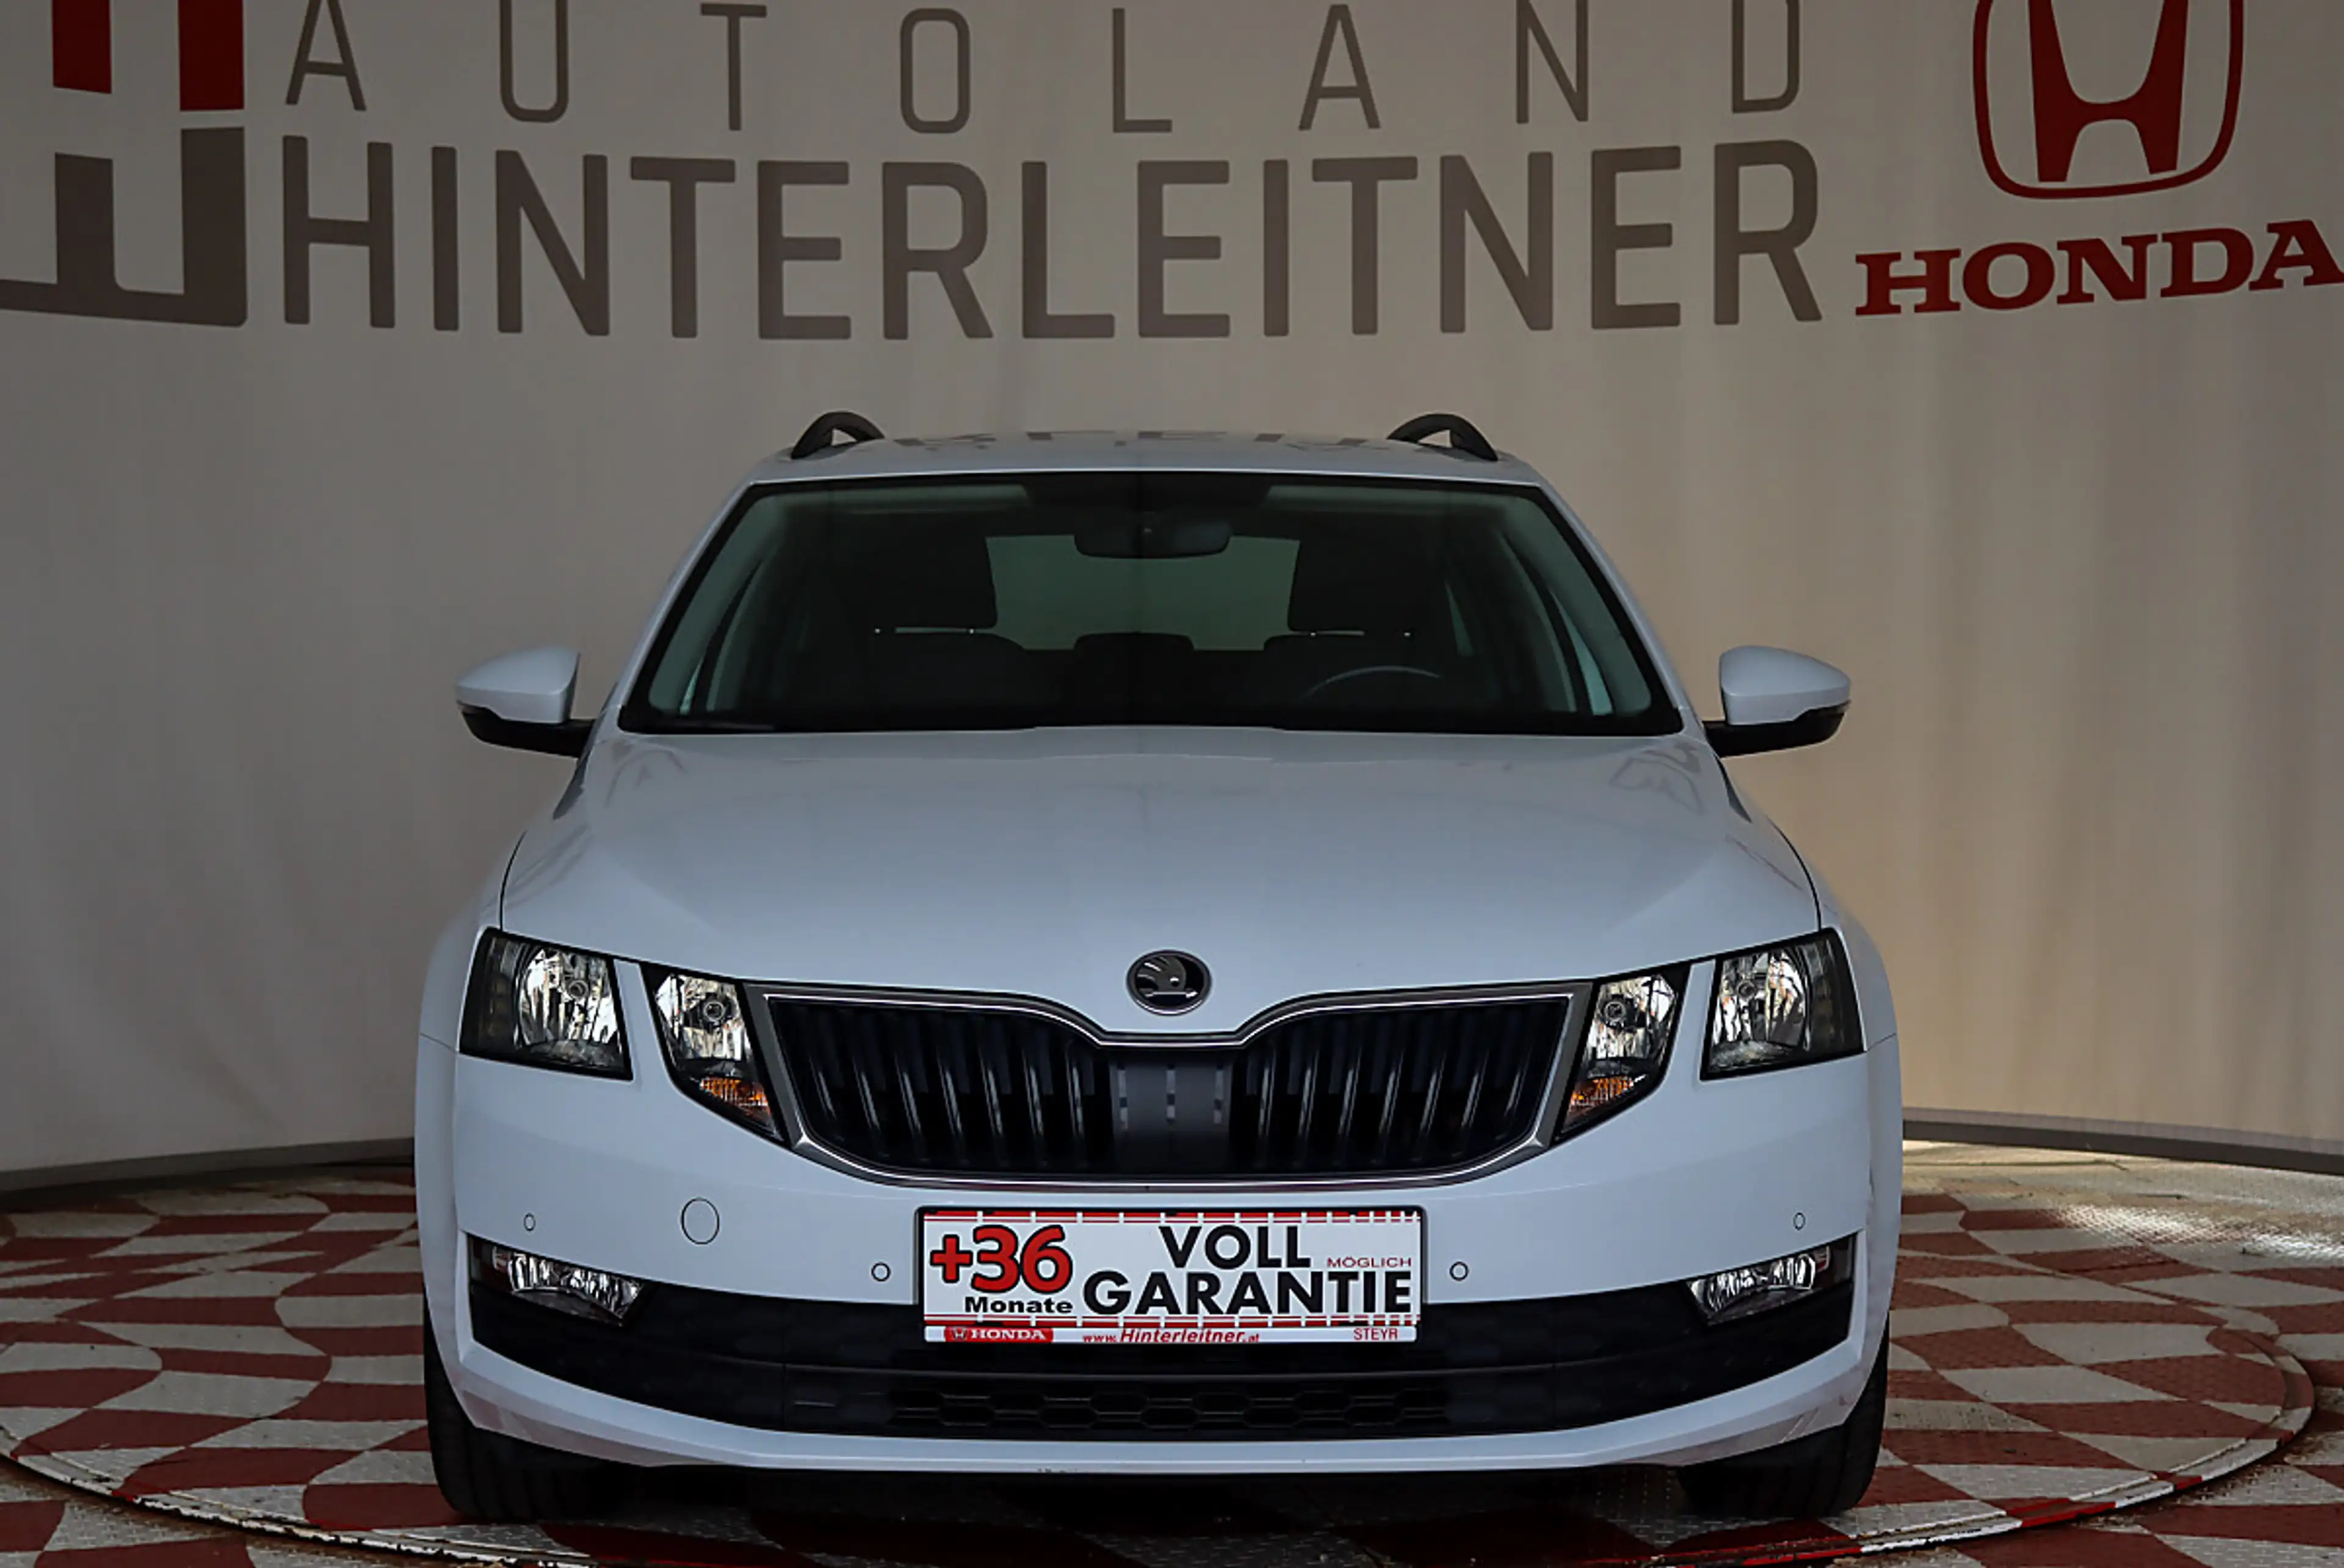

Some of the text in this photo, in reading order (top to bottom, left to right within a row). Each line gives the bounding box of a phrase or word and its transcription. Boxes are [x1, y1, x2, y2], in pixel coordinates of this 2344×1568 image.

[284, 0, 1801, 133] AUTOLAND
[282, 135, 1823, 340] HINTERLEITNER
[1854, 219, 2344, 317] HONDA
[930, 1224, 1074, 1295] +36
[1159, 1224, 1311, 1270] VOLL
[1326, 1257, 1412, 1268] MÖGLICH
[964, 1296, 1074, 1313] Monate
[1083, 1270, 1411, 1315] GARANTIE
[971, 1329, 1046, 1340] HONDA
[1353, 1328, 1398, 1341] STEYR
